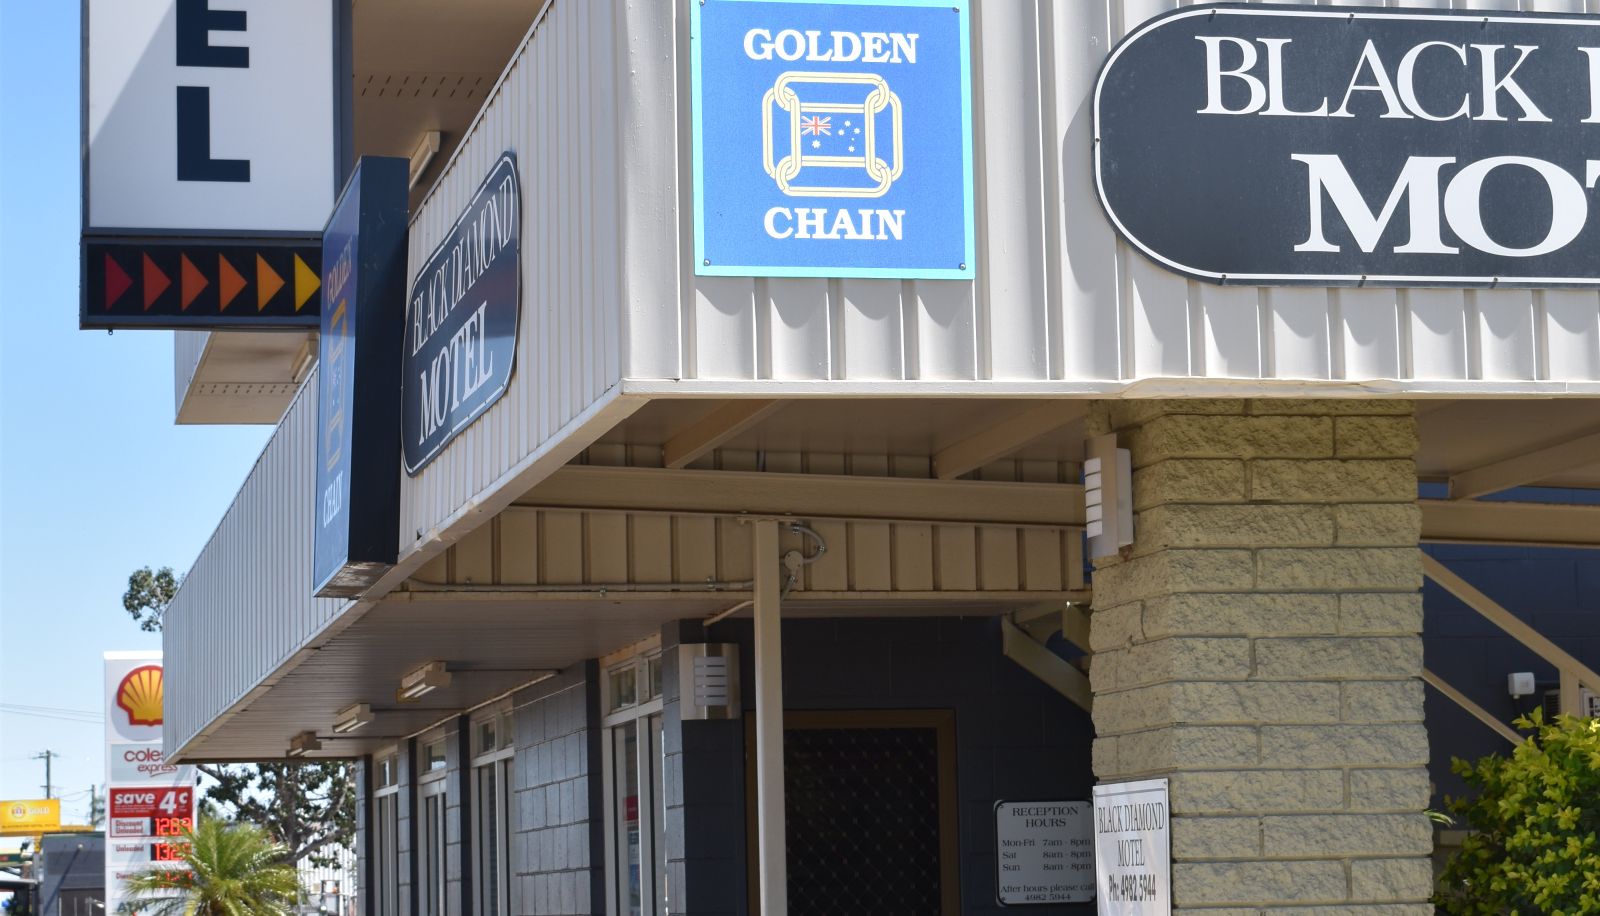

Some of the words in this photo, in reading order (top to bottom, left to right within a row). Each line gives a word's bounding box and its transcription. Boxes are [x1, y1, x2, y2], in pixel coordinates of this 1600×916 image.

[743, 28, 919, 64] GOLDEN
[1194, 35, 1553, 122] BLACK
[1290, 153, 1600, 257] MO
[763, 206, 906, 240] CHAIN
[327, 235, 353, 311] GOLDEN
[411, 259, 450, 357] BLACK
[450, 174, 514, 312] DIAMOND
[418, 300, 494, 446] MOTEL
[323, 470, 344, 529] CHAIN
[137, 764, 178, 774] express
[115, 792, 156, 805] save
[1012, 806, 1079, 816] RECEPTION
[1025, 818, 1066, 828] HOURS
[1097, 805, 1123, 834] BLACK
[1124, 801, 1165, 832] DIAMOND
[1002, 851, 1016, 859] Sat
[1042, 851, 1063, 859] 8am
[1070, 850, 1091, 859] 8pm
[1042, 839, 1062, 847] 7am
[1070, 838, 1091, 848] 8pm
[1117, 839, 1145, 867] MOTEL
[1002, 864, 1020, 872] Sun
[1042, 863, 1063, 871] 8am
[1070, 863, 1092, 872] 8pm
[1001, 885, 1021, 893] After
[1023, 884, 1048, 892] hours
[1049, 883, 1078, 893] please
[1120, 873, 1137, 902] 4982
[1139, 873, 1156, 902] 5944
